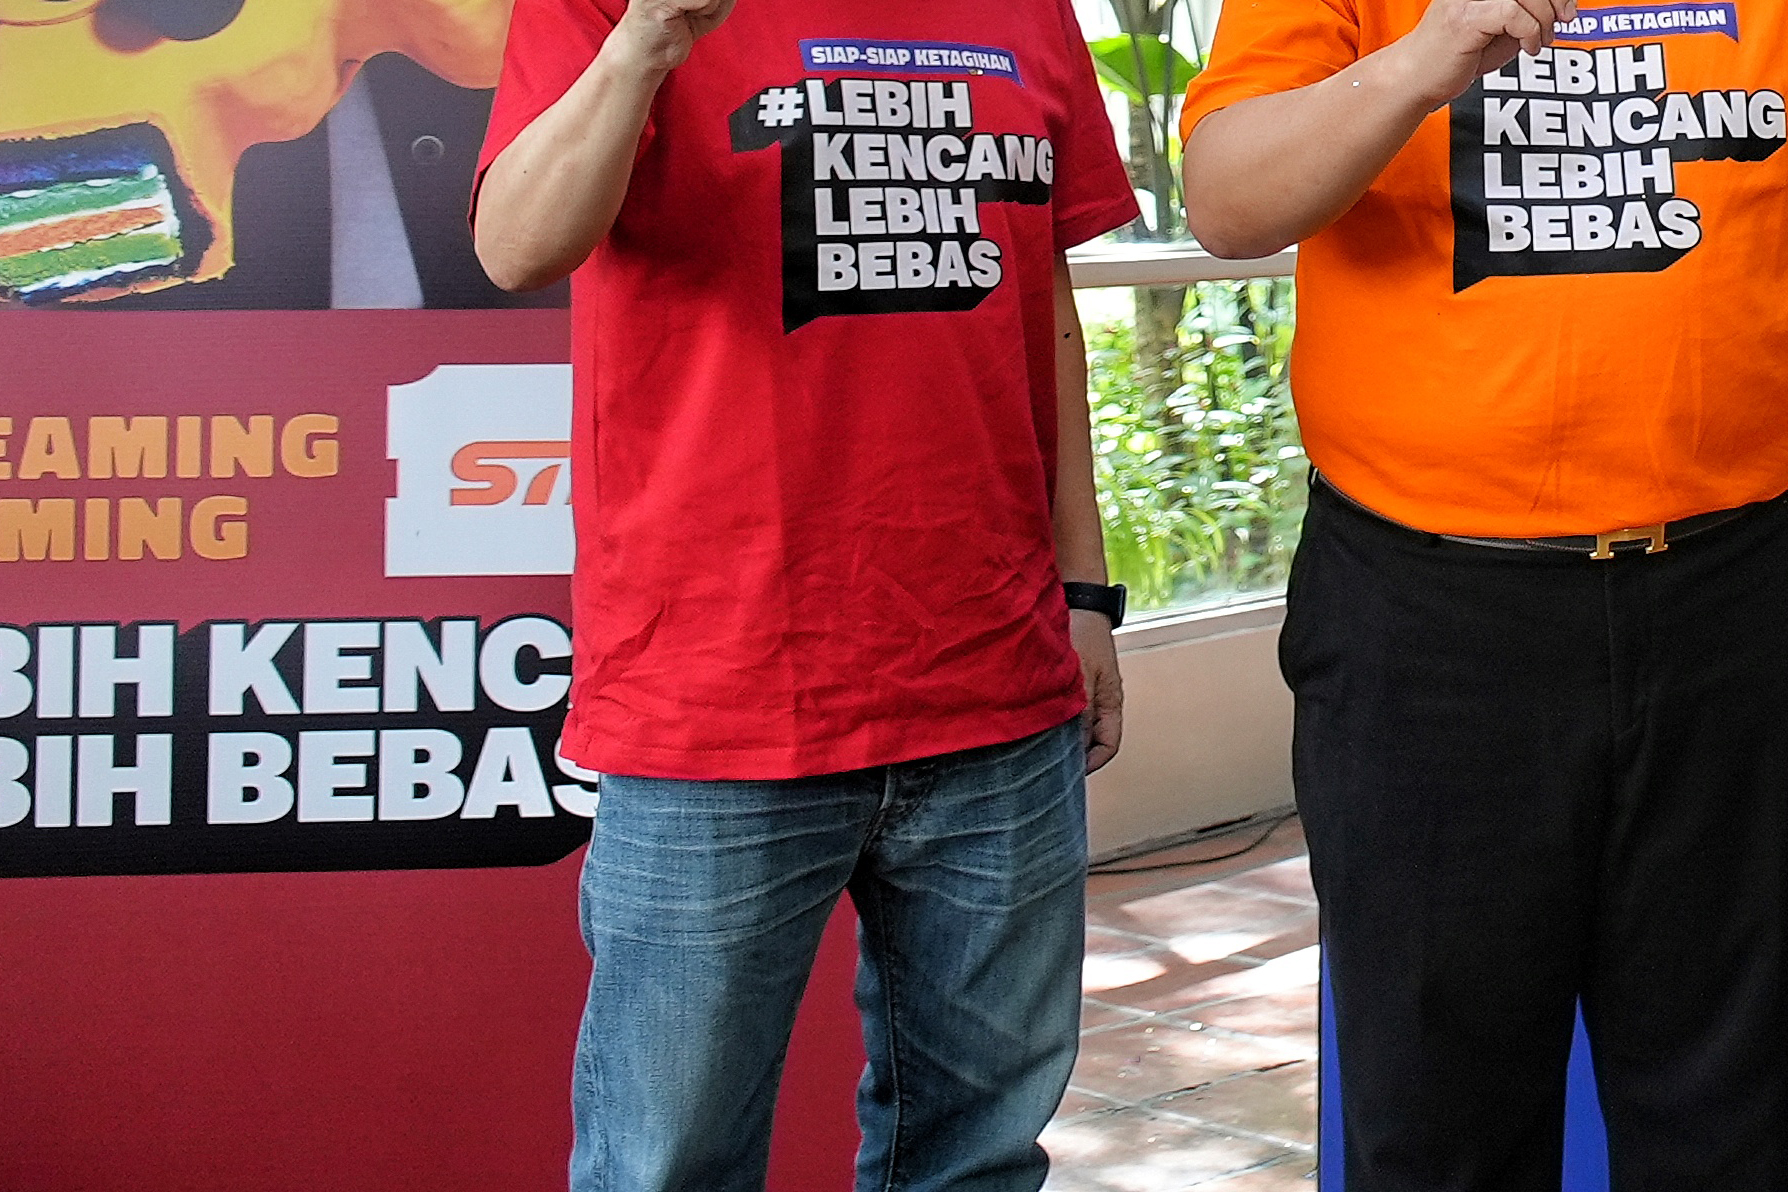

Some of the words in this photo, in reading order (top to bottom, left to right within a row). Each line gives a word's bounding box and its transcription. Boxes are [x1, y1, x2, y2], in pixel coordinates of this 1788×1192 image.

[1602, 9, 1727, 33] KETAGIHAN
[811, 46, 911, 67] SIAP-SIAP
[915, 49, 1013, 73] KETAGIHAN
[757, 78, 973, 129] #LEBIH
[1483, 89, 1788, 148] KENCANG
[812, 132, 1055, 186] KENCANG
[1483, 147, 1674, 201] LEBIH
[814, 186, 981, 237] LEBIH
[1487, 197, 1702, 253] BEBAS
[816, 239, 1003, 293] BEBAS
[0, 413, 340, 481] AMING
